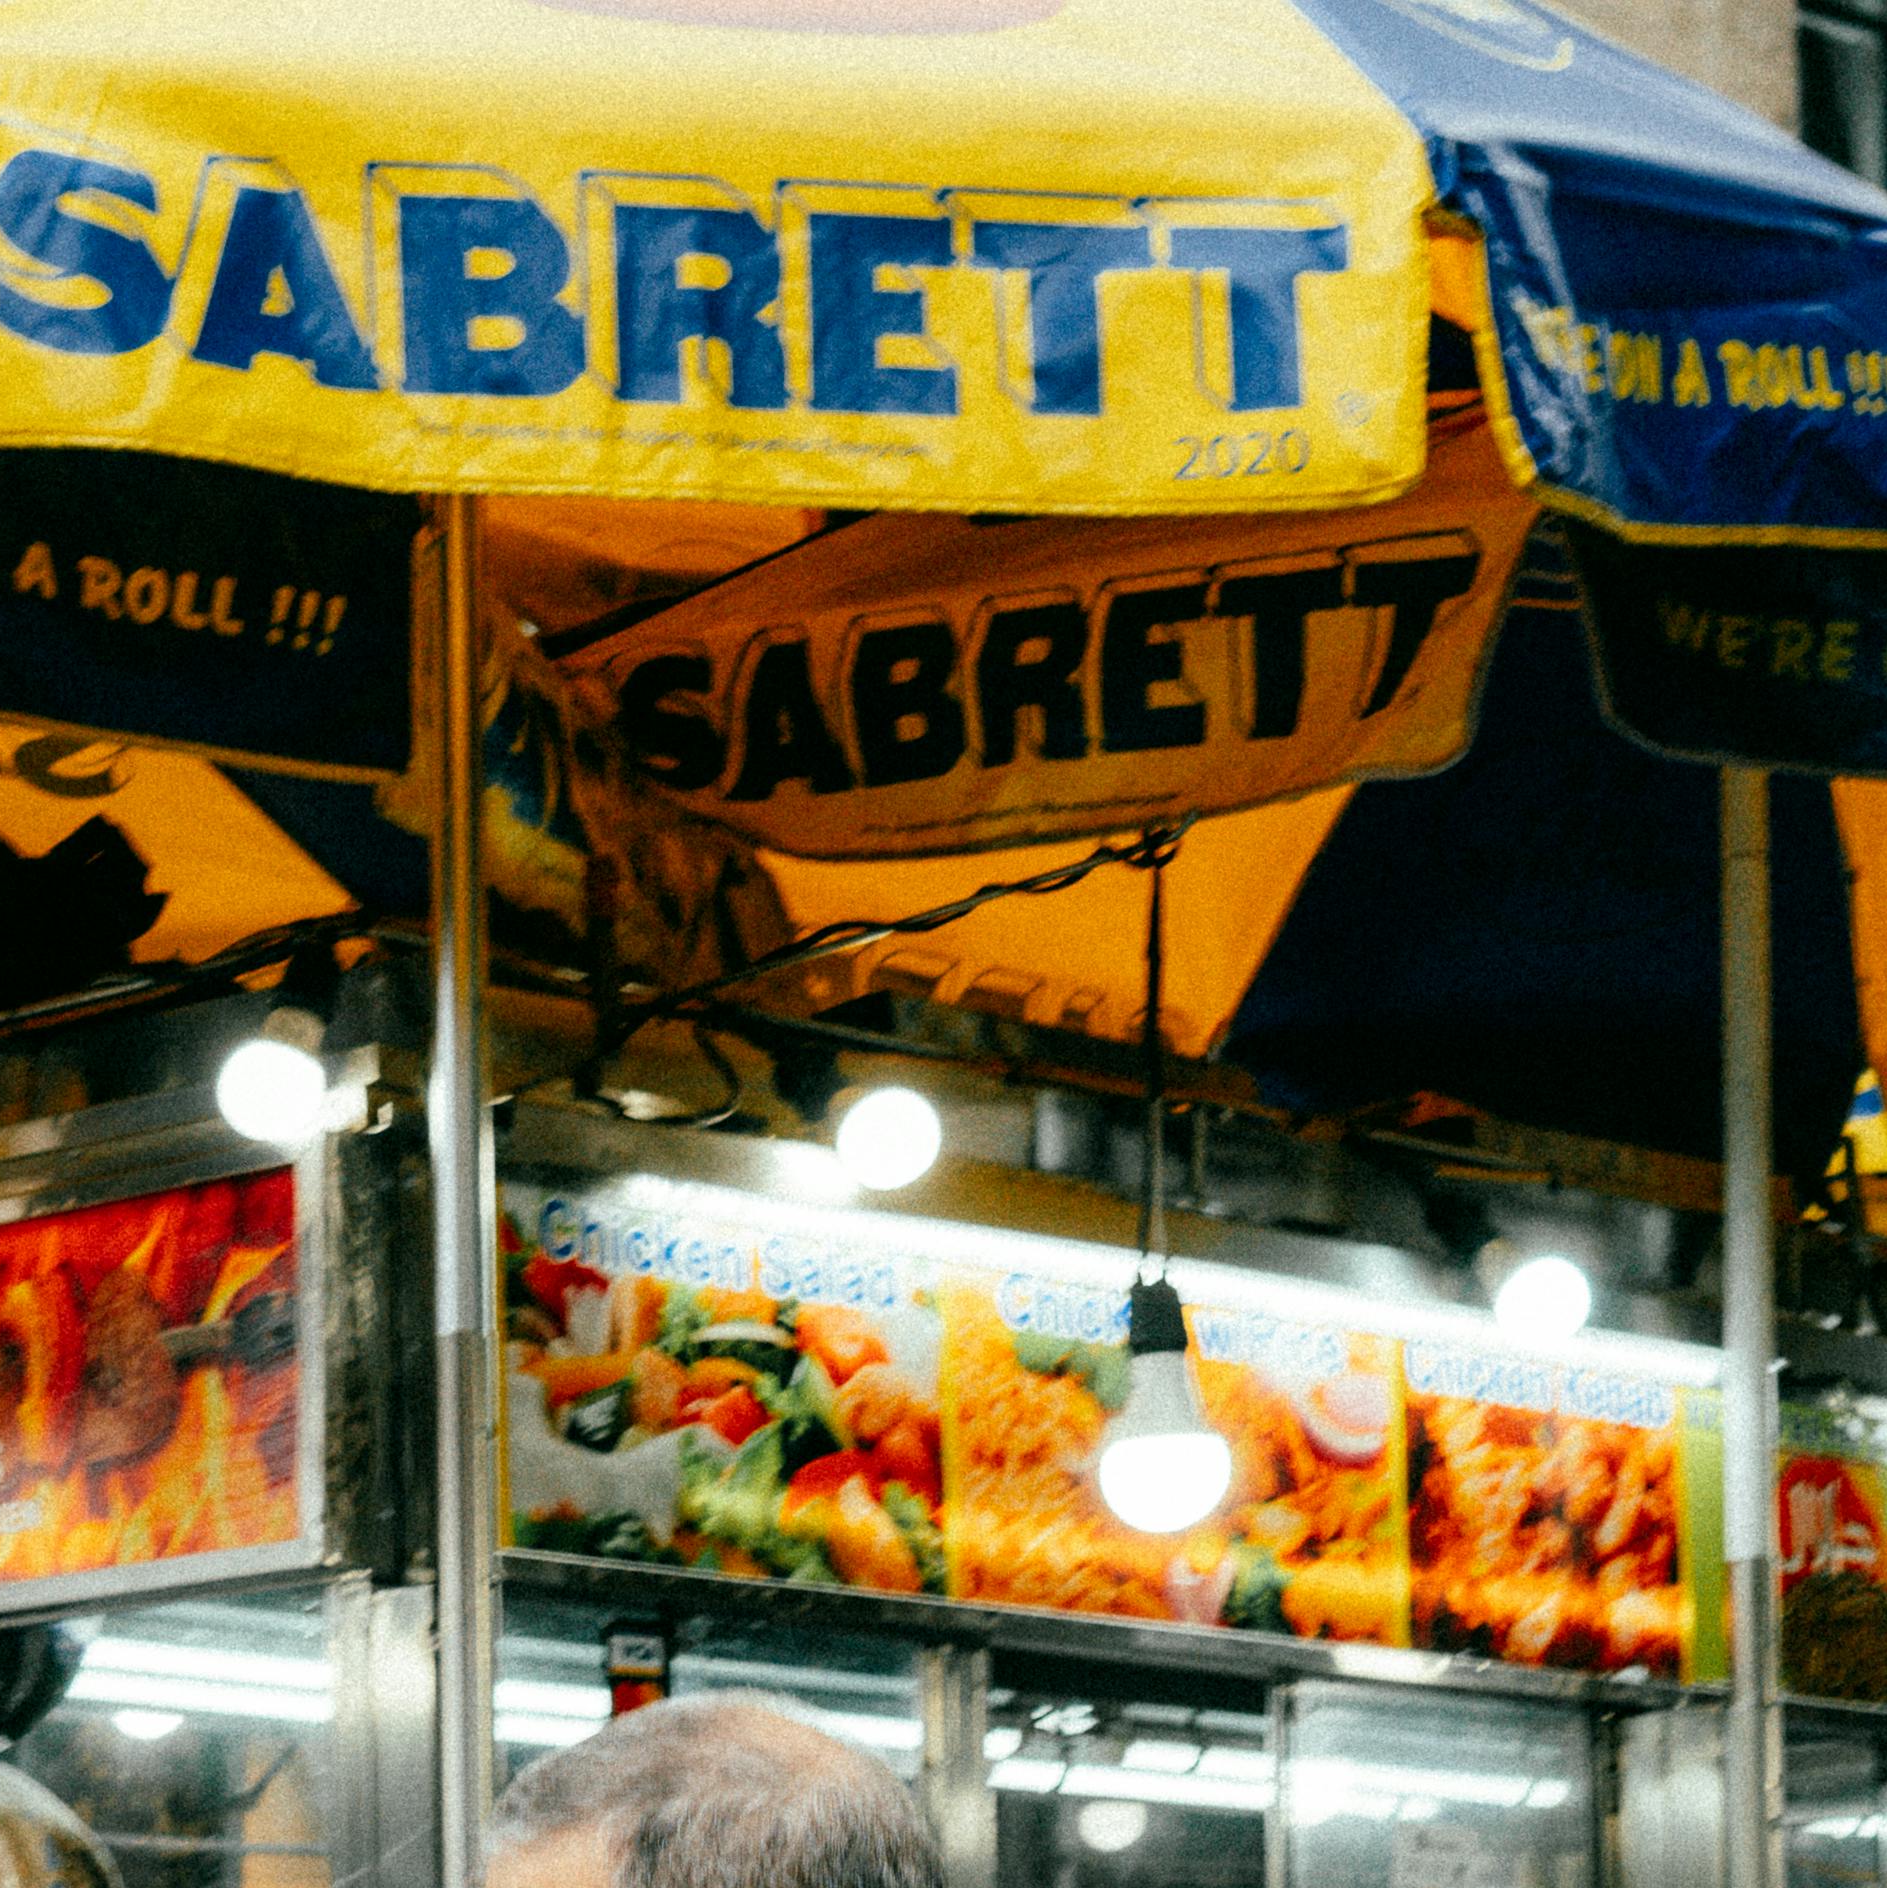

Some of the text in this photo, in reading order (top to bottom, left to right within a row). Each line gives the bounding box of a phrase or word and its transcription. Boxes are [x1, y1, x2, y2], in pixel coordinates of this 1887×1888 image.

[1674, 339, 1710, 408] A
[1719, 340, 1843, 411] ROLL
[1174, 430, 1312, 480] 2020
[12, 539, 59, 600] A
[76, 554, 245, 638] ROLL
[265, 584, 348, 657] !!!
[612, 532, 1482, 800] SABRETT
[538, 1198, 747, 1294] Chicken
